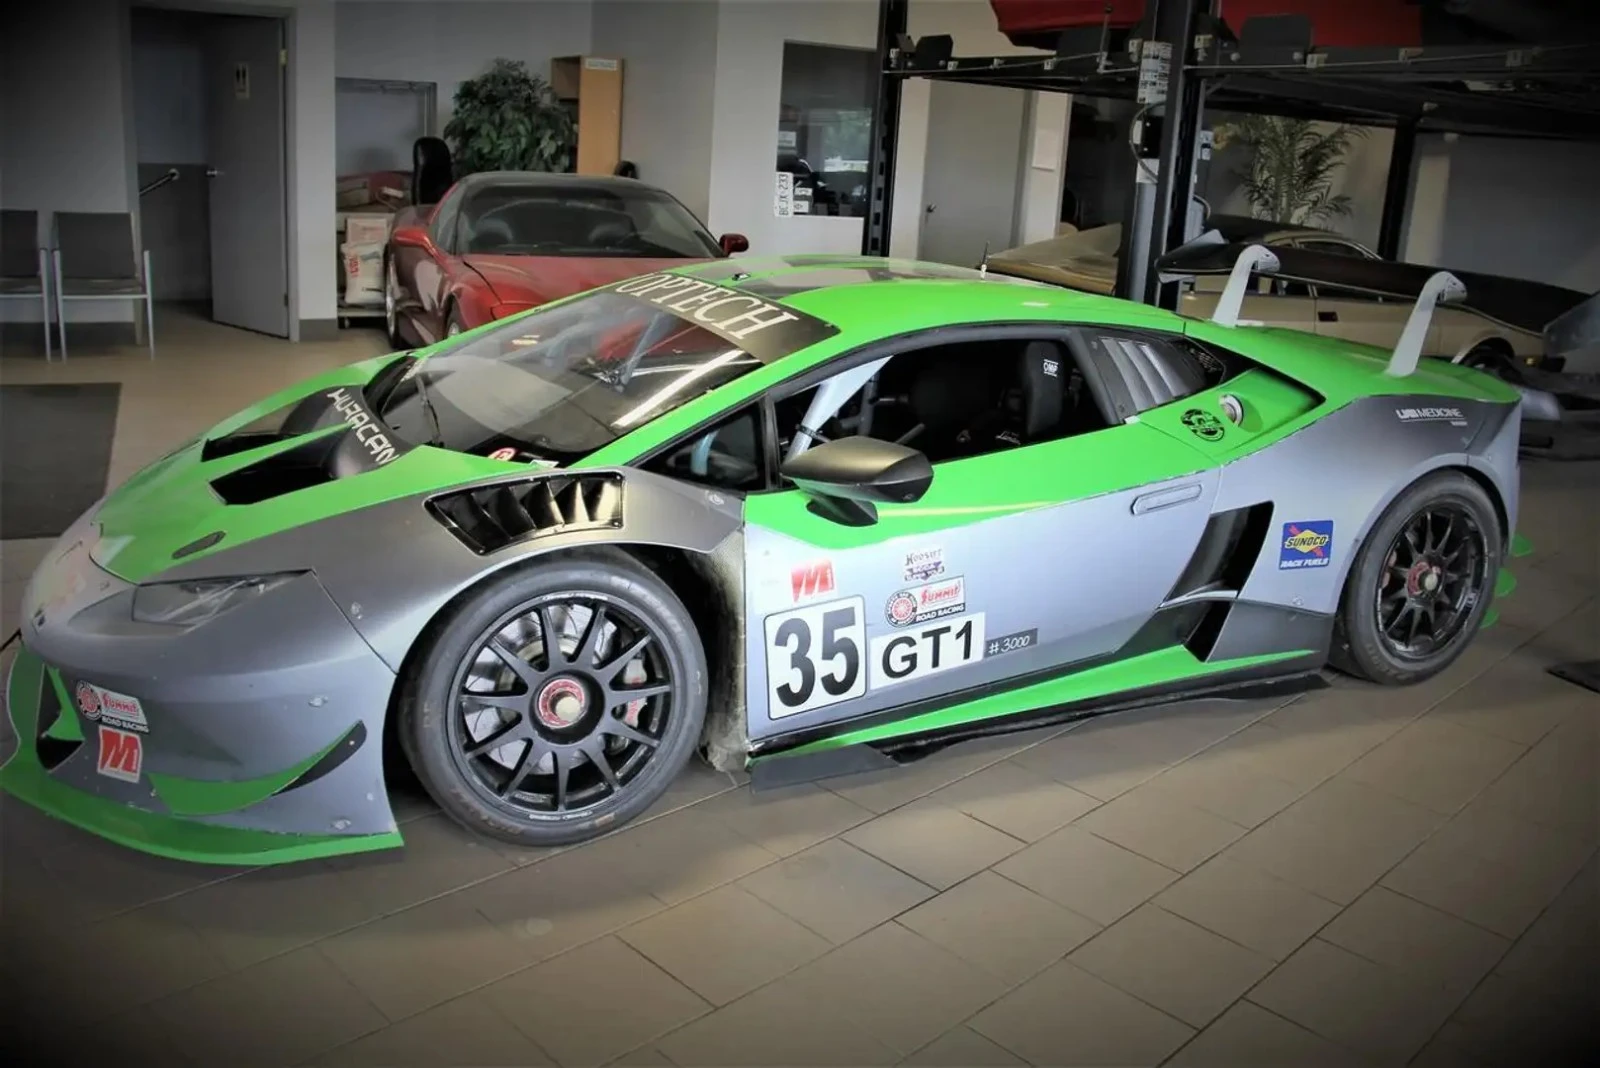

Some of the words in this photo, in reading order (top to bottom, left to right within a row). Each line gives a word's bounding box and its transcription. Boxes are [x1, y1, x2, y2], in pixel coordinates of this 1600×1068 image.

[326, 387, 400, 465] HURACAN
[1286, 536, 1327, 547] SUNOCO
[916, 611, 938, 622] ROAD
[937, 604, 965, 617] RACING
[774, 606, 860, 708] 35
[881, 620, 973, 679] GT1
[101, 714, 122, 727] ROAD
[122, 720, 149, 733] RACING
